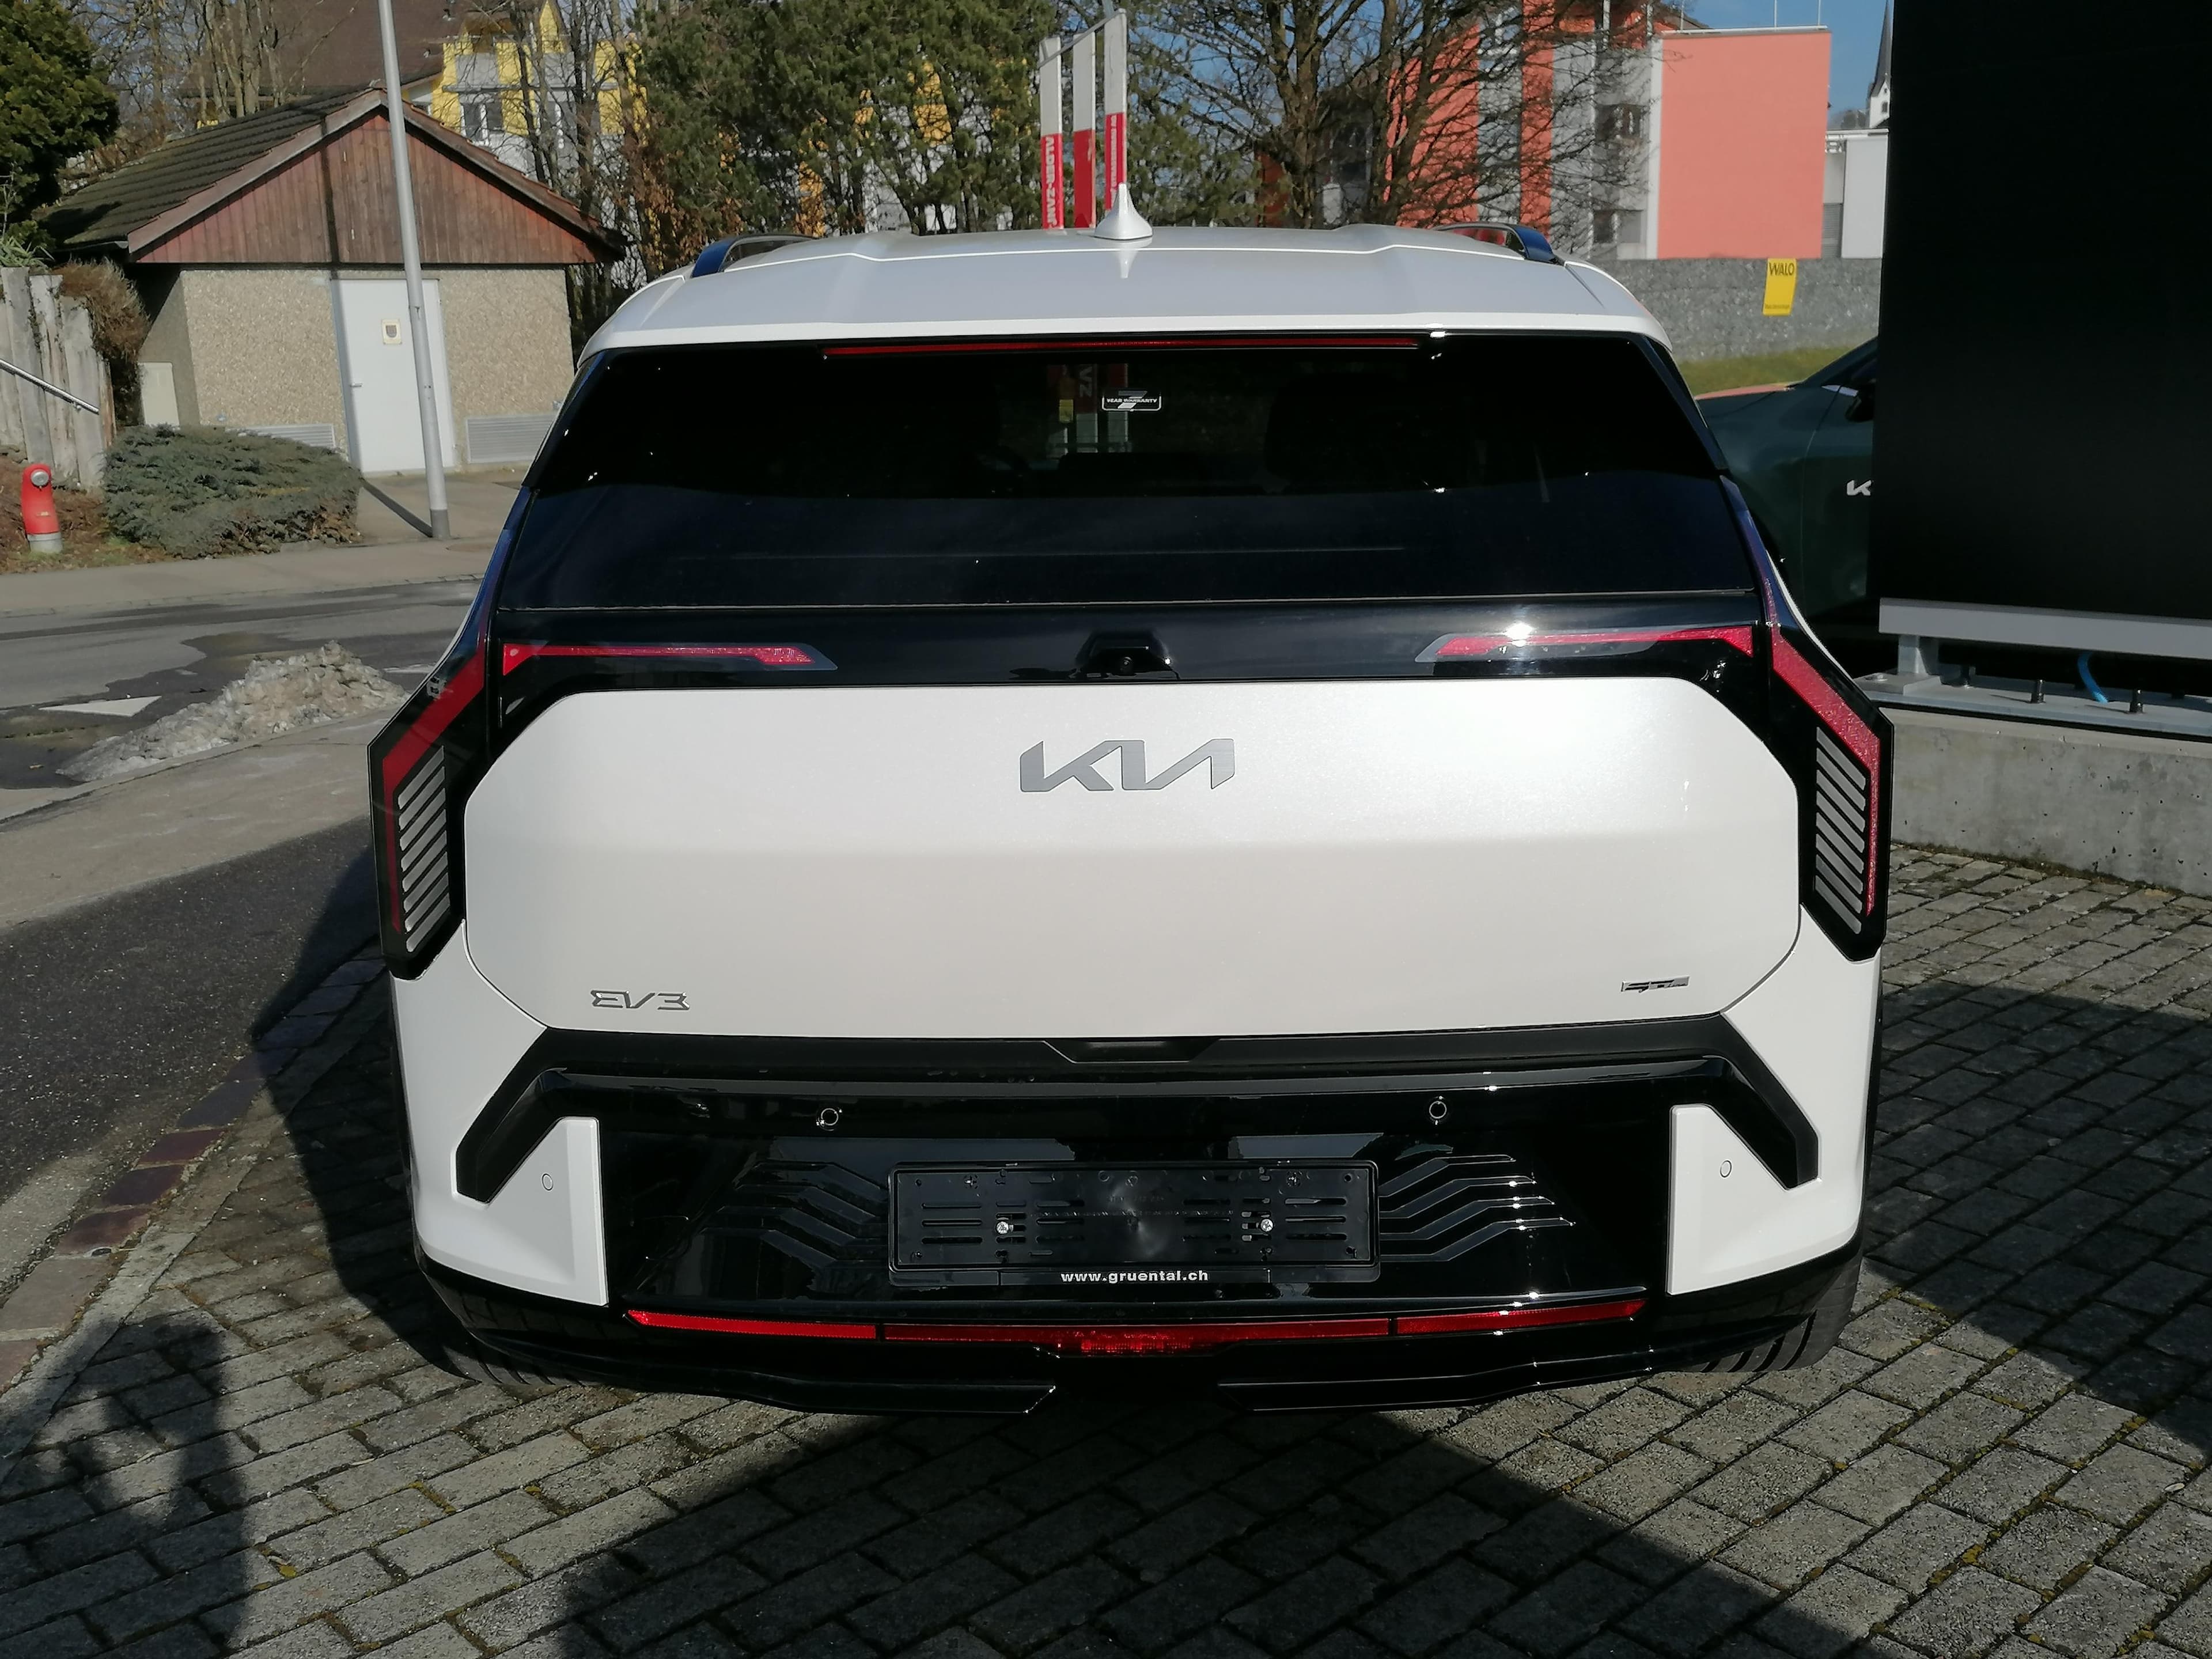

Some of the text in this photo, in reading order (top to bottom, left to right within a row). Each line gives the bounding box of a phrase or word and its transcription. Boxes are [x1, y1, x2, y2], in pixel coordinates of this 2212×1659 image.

[1769, 262, 1794, 276] WALO
[1020, 738, 1235, 792] KIA
[590, 990, 690, 1010] EV3
[1060, 1270, 1209, 1284] www.gruental.ch
